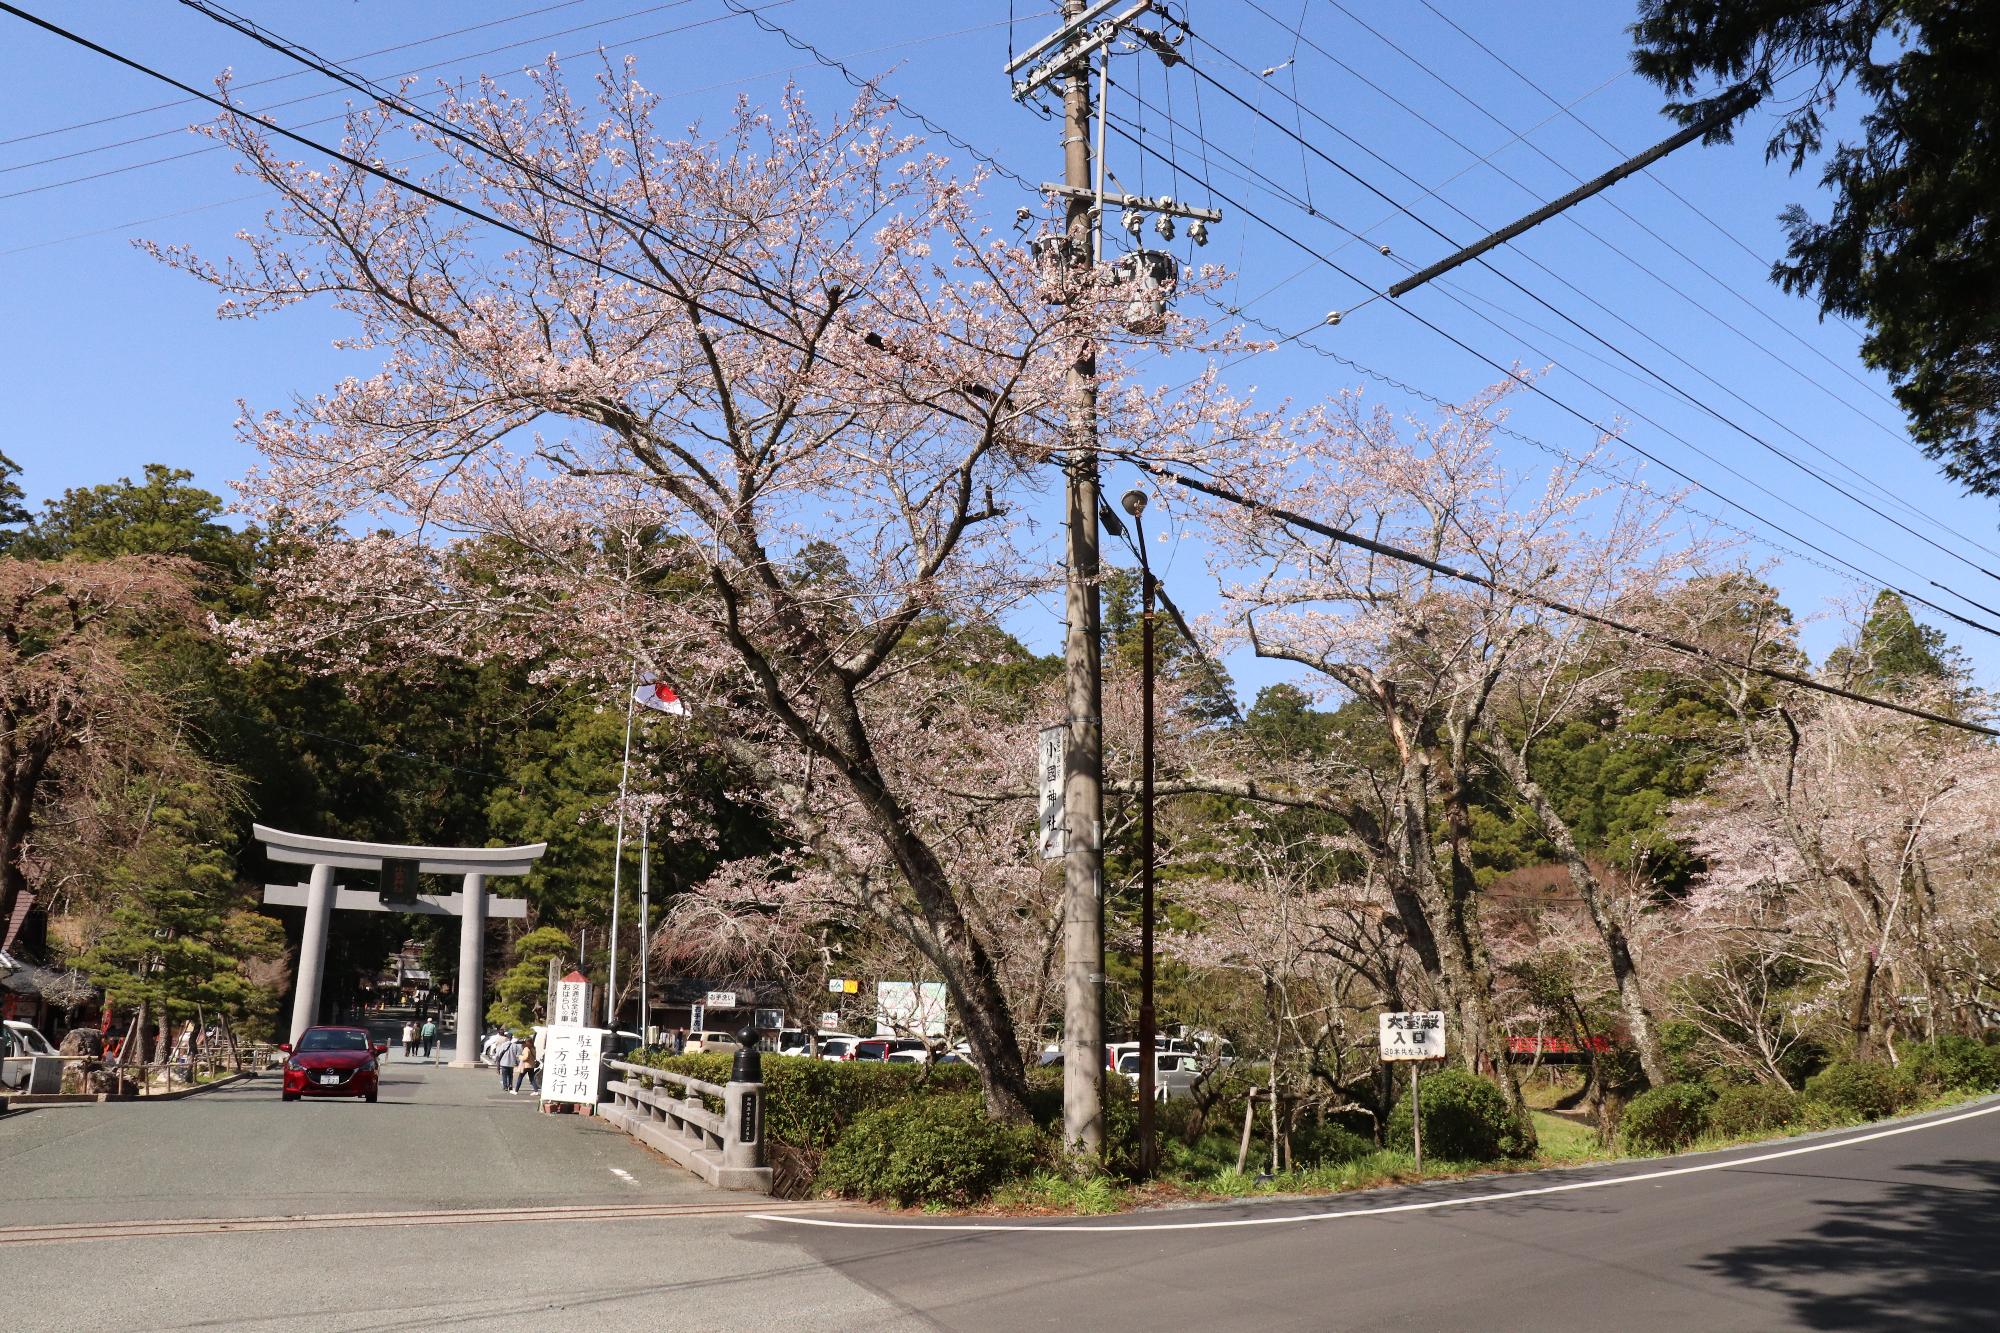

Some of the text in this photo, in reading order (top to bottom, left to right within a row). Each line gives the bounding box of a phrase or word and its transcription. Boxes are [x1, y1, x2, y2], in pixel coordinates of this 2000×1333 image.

[552, 1036, 570, 1094] 一方通行
[574, 1034, 592, 1096] 駐車場内
[1393, 1031, 1426, 1044] 入口
